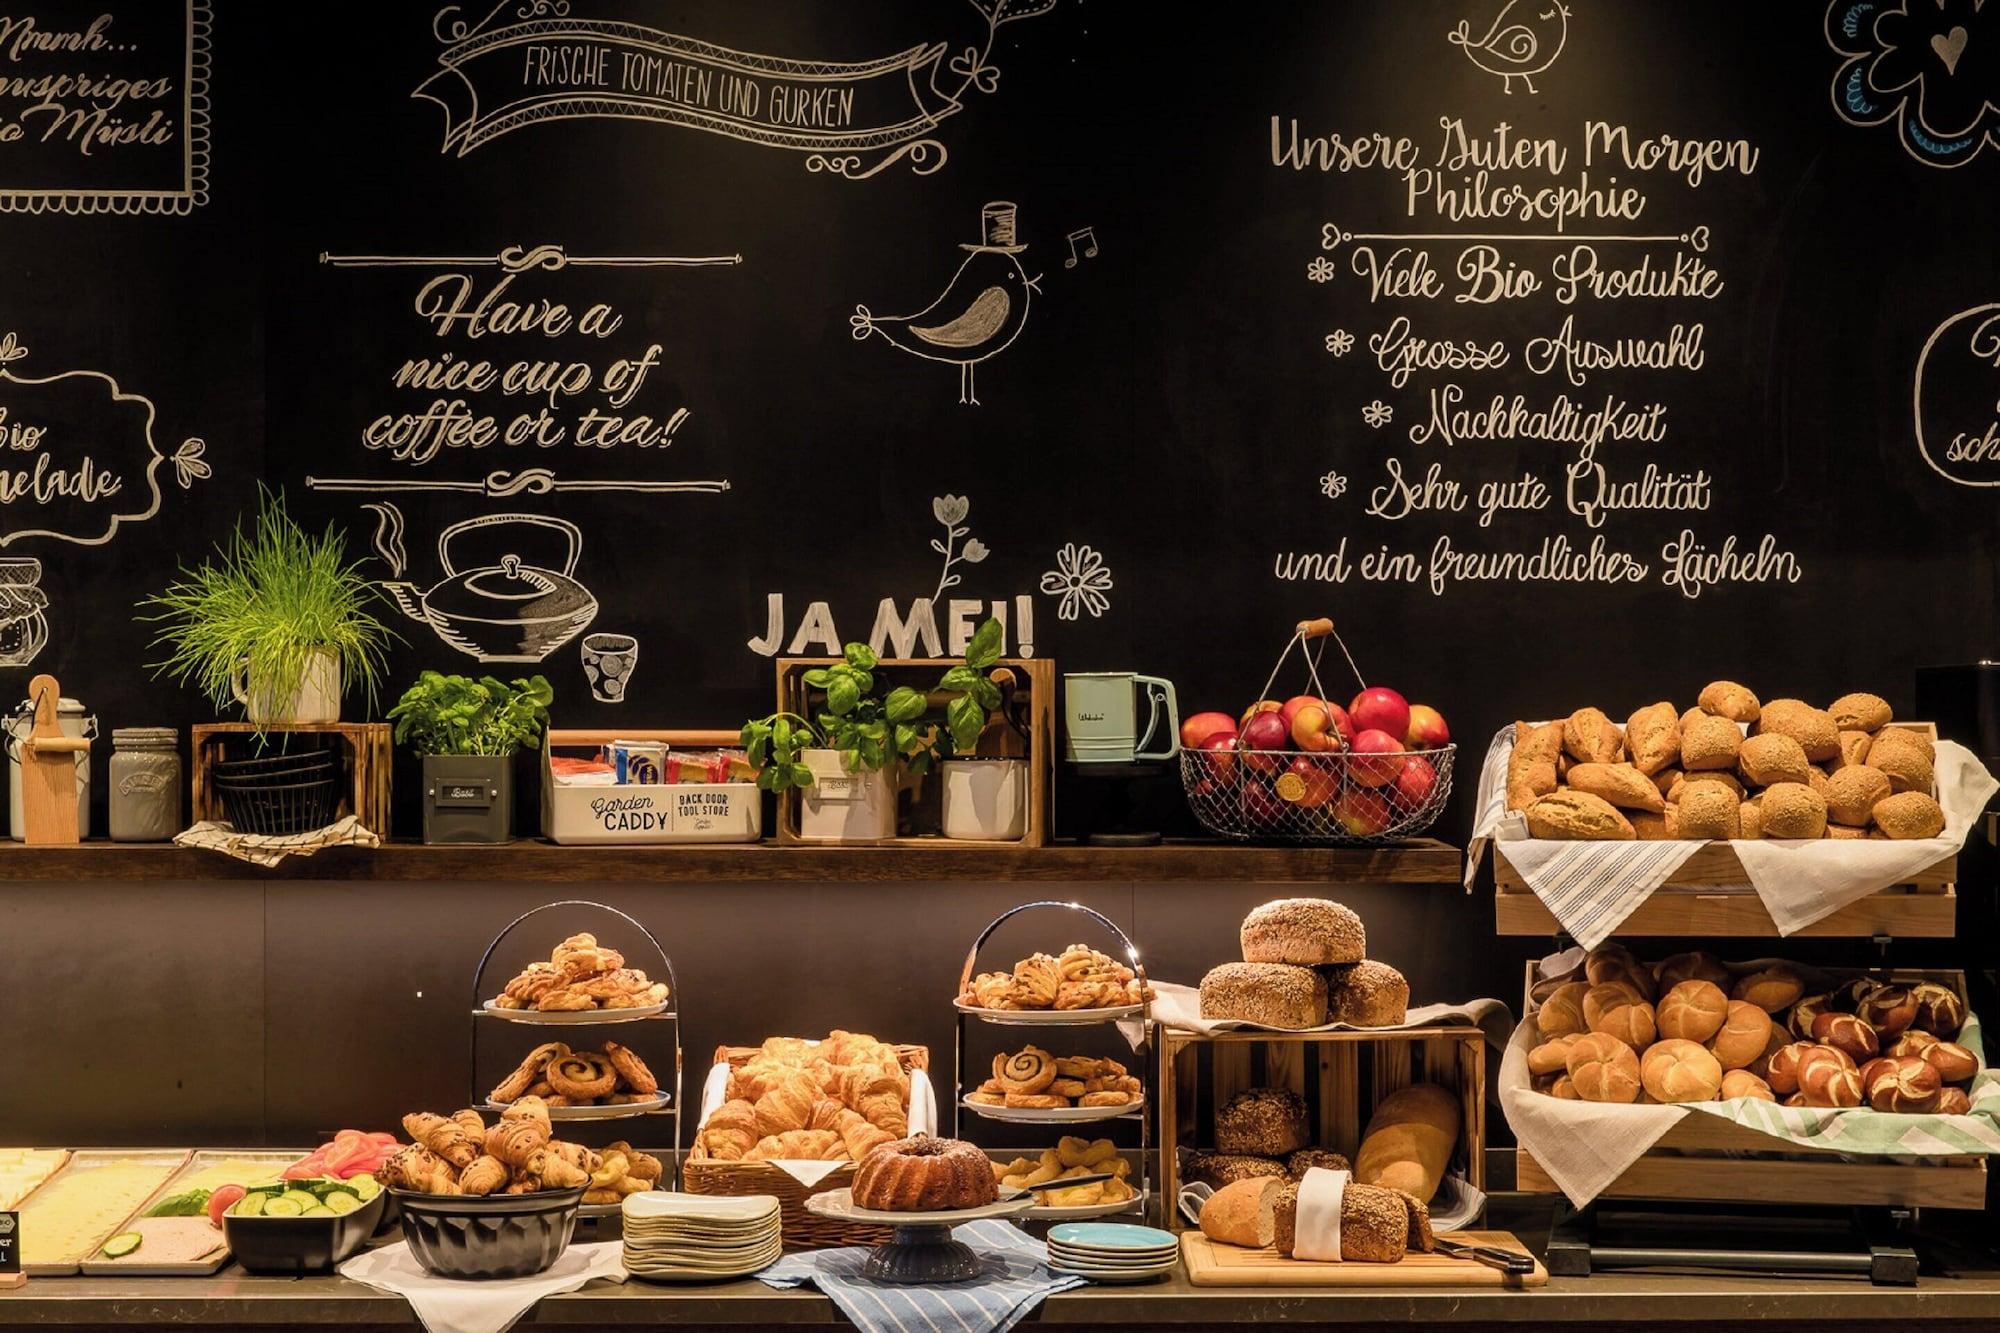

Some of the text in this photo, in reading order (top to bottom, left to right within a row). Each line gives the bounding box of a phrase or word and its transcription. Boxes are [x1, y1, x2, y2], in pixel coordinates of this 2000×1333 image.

[622, 52, 713, 106] TOMATEN
[719, 74, 760, 117] UND
[769, 86, 854, 126] GURKEN
[20, 101, 174, 156] Müsli
[1271, 115, 1419, 172] Unsere
[1585, 121, 1759, 188] Morgen
[1404, 168, 1646, 232] Philosophie
[414, 273, 623, 340] Have a
[1352, 246, 1444, 303] Viele
[1455, 245, 1542, 304] Bio
[392, 344, 663, 410] nice cup of
[1369, 315, 1704, 388] Grosse Auswahl
[363, 399, 692, 466] coffee or tea!
[1364, 457, 1711, 528] Sehr gute Qualität
[1274, 528, 1801, 599] und ein freundliches Lächeln
[747, 593, 1034, 660] JA MEI!
[590, 794, 654, 820] Garden
[604, 811, 669, 831] CADDY
[678, 804, 729, 817] TOOL STORE
[679, 793, 728, 806] BACK DOOR
